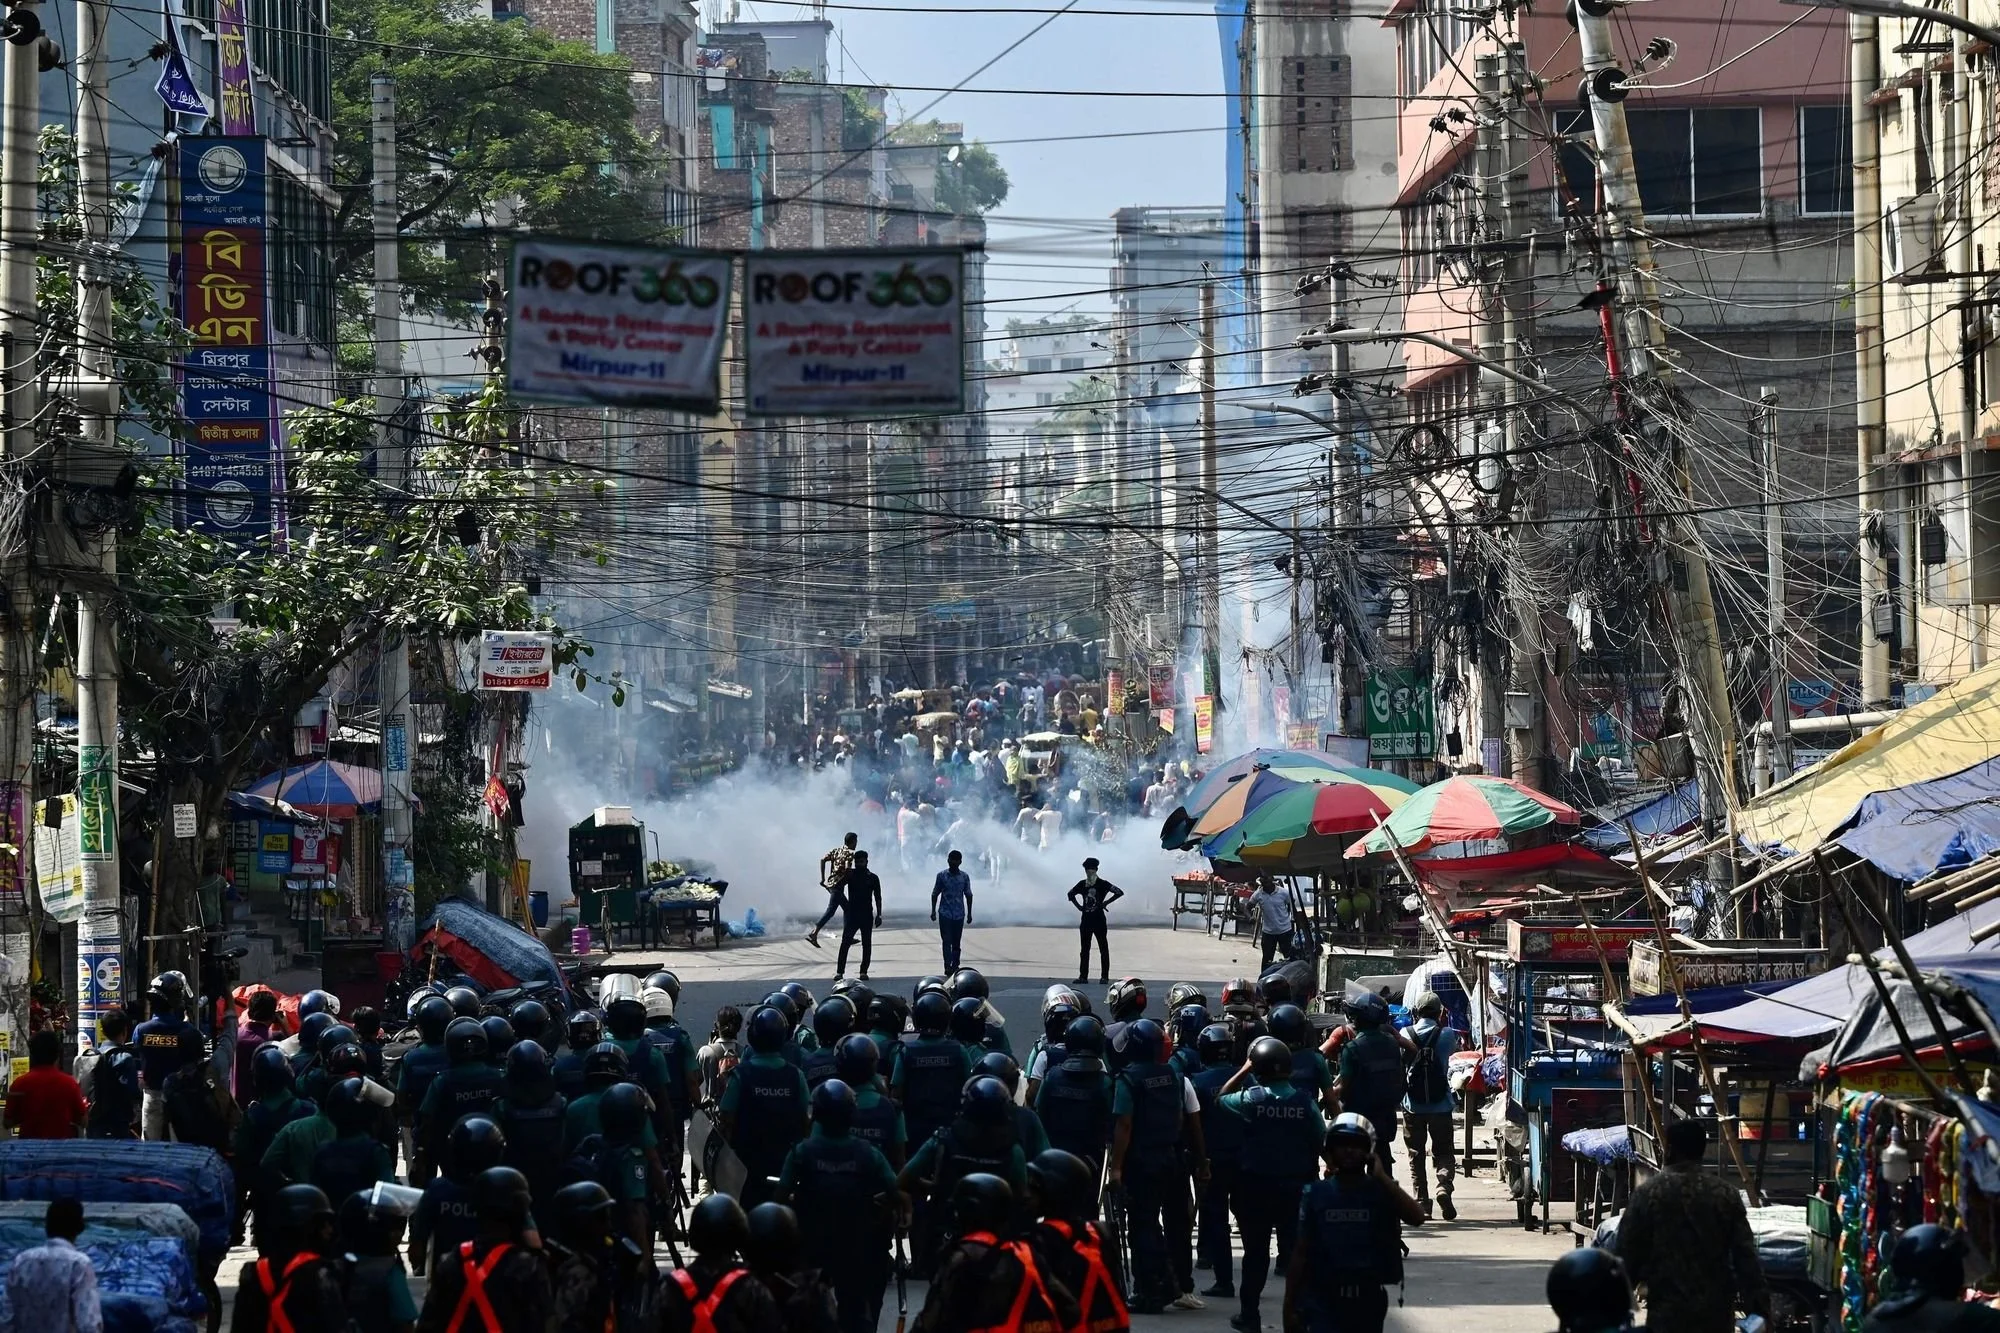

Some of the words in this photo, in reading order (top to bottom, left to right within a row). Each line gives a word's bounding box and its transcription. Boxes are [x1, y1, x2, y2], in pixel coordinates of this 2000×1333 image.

[224, 215, 247, 224] আমরাই
[249, 215, 262, 224] দেই
[566, 328, 619, 350] Party
[623, 333, 684, 354] Center
[806, 340, 858, 358] Party
[863, 338, 924, 355] Center
[200, 350, 251, 369] মিরপুর
[560, 351, 665, 378] Mirpur-11
[801, 363, 905, 385] Mirpur-11
[201, 396, 252, 412] সেন্টার
[200, 425, 229, 440] দ্বিতীয়
[231, 428, 260, 439] তলায়
[509, 649, 543, 659] ইন্টারনেট
[145, 1036, 178, 1046] PRESS
[455, 1088, 493, 1103] POLICE
[754, 1087, 792, 1097] POLICE
[1256, 1105, 1305, 1119] POLICE
